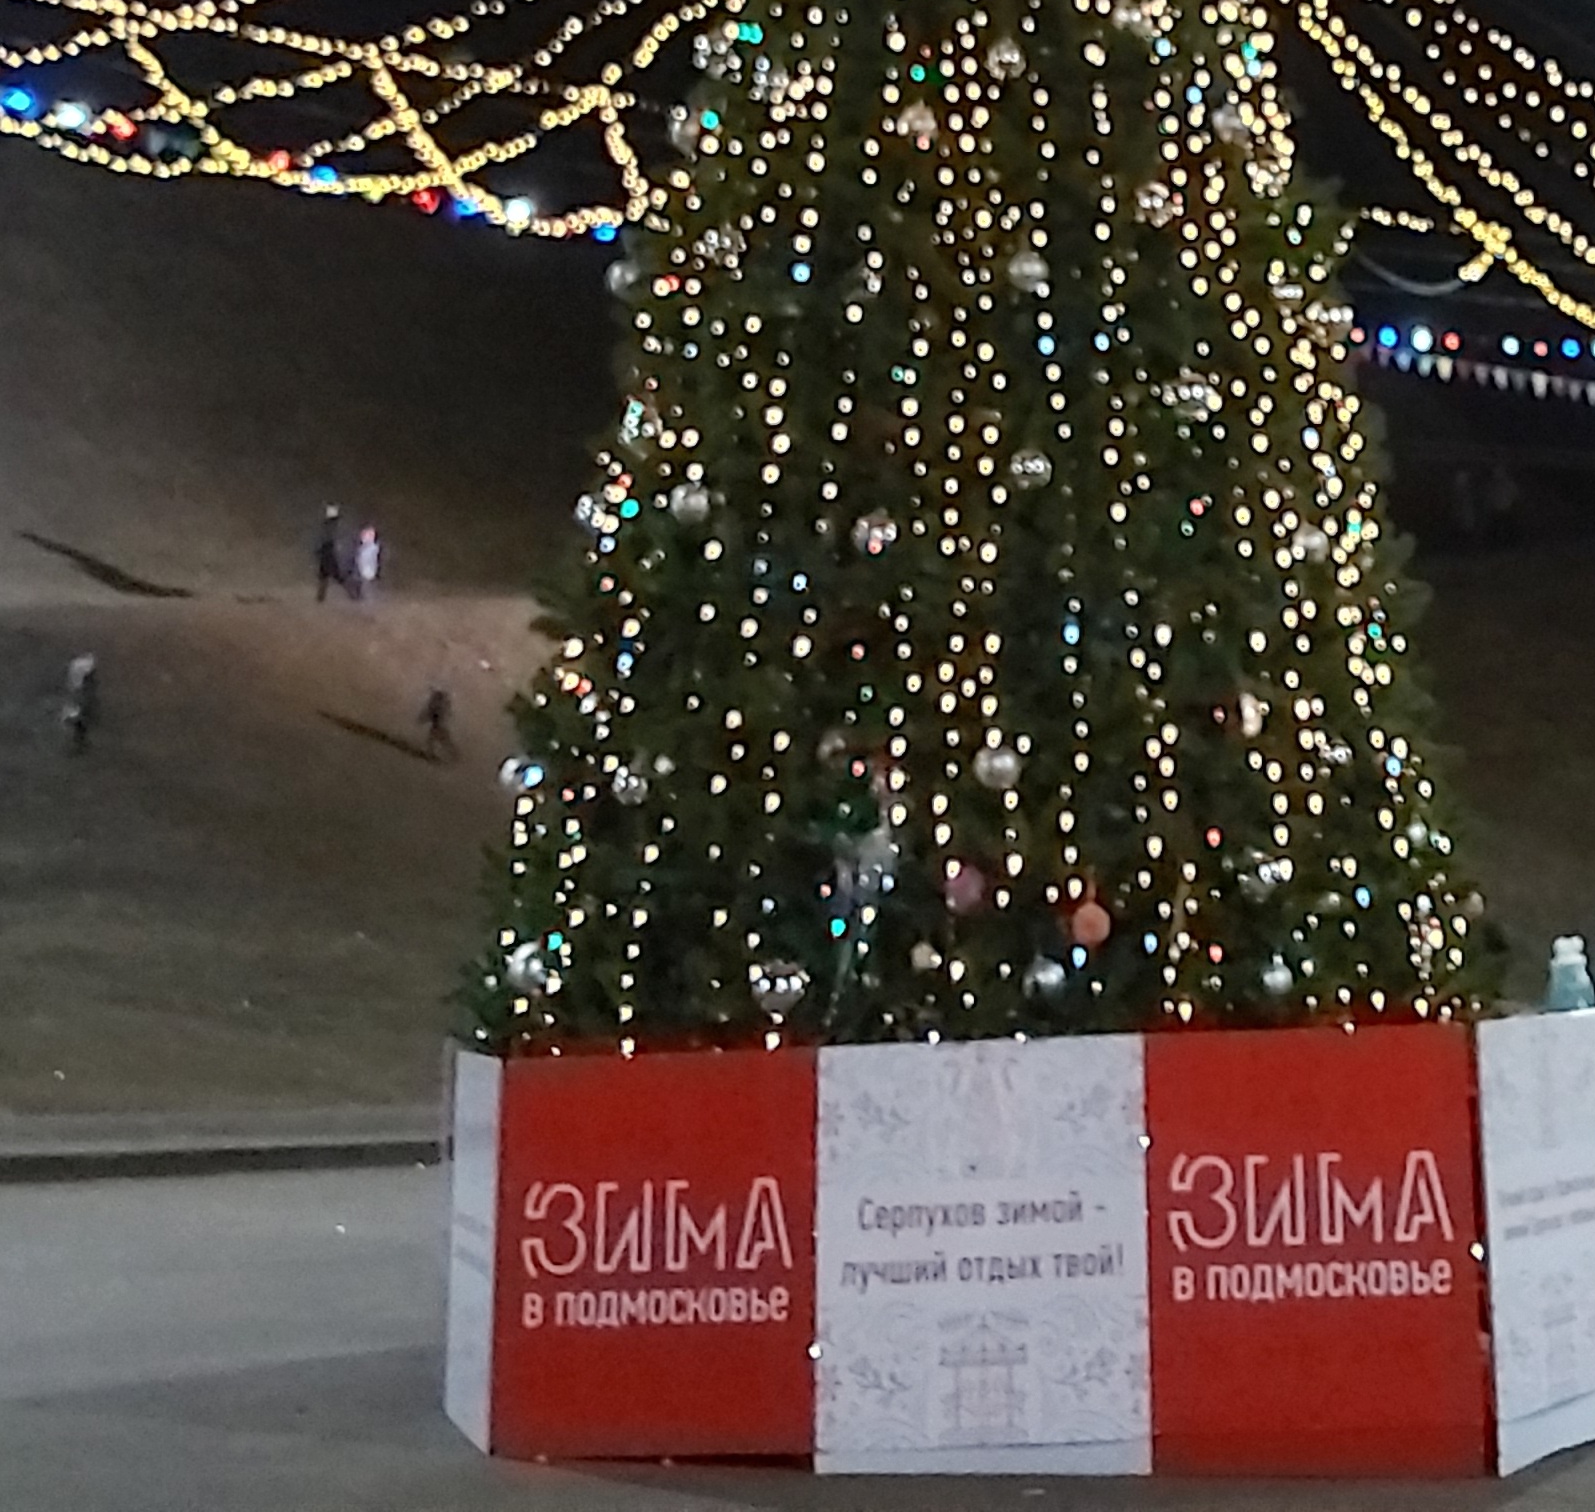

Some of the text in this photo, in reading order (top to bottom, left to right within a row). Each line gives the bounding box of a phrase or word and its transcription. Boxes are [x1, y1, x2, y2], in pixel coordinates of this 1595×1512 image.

[521, 1175, 793, 1279] ЗИМА
[857, 1197, 986, 1237] Серпухов
[995, 1190, 1083, 1225] зимой
[1168, 1149, 1455, 1252] ЗИМА
[840, 1242, 1123, 1295] лучший отдых твой!
